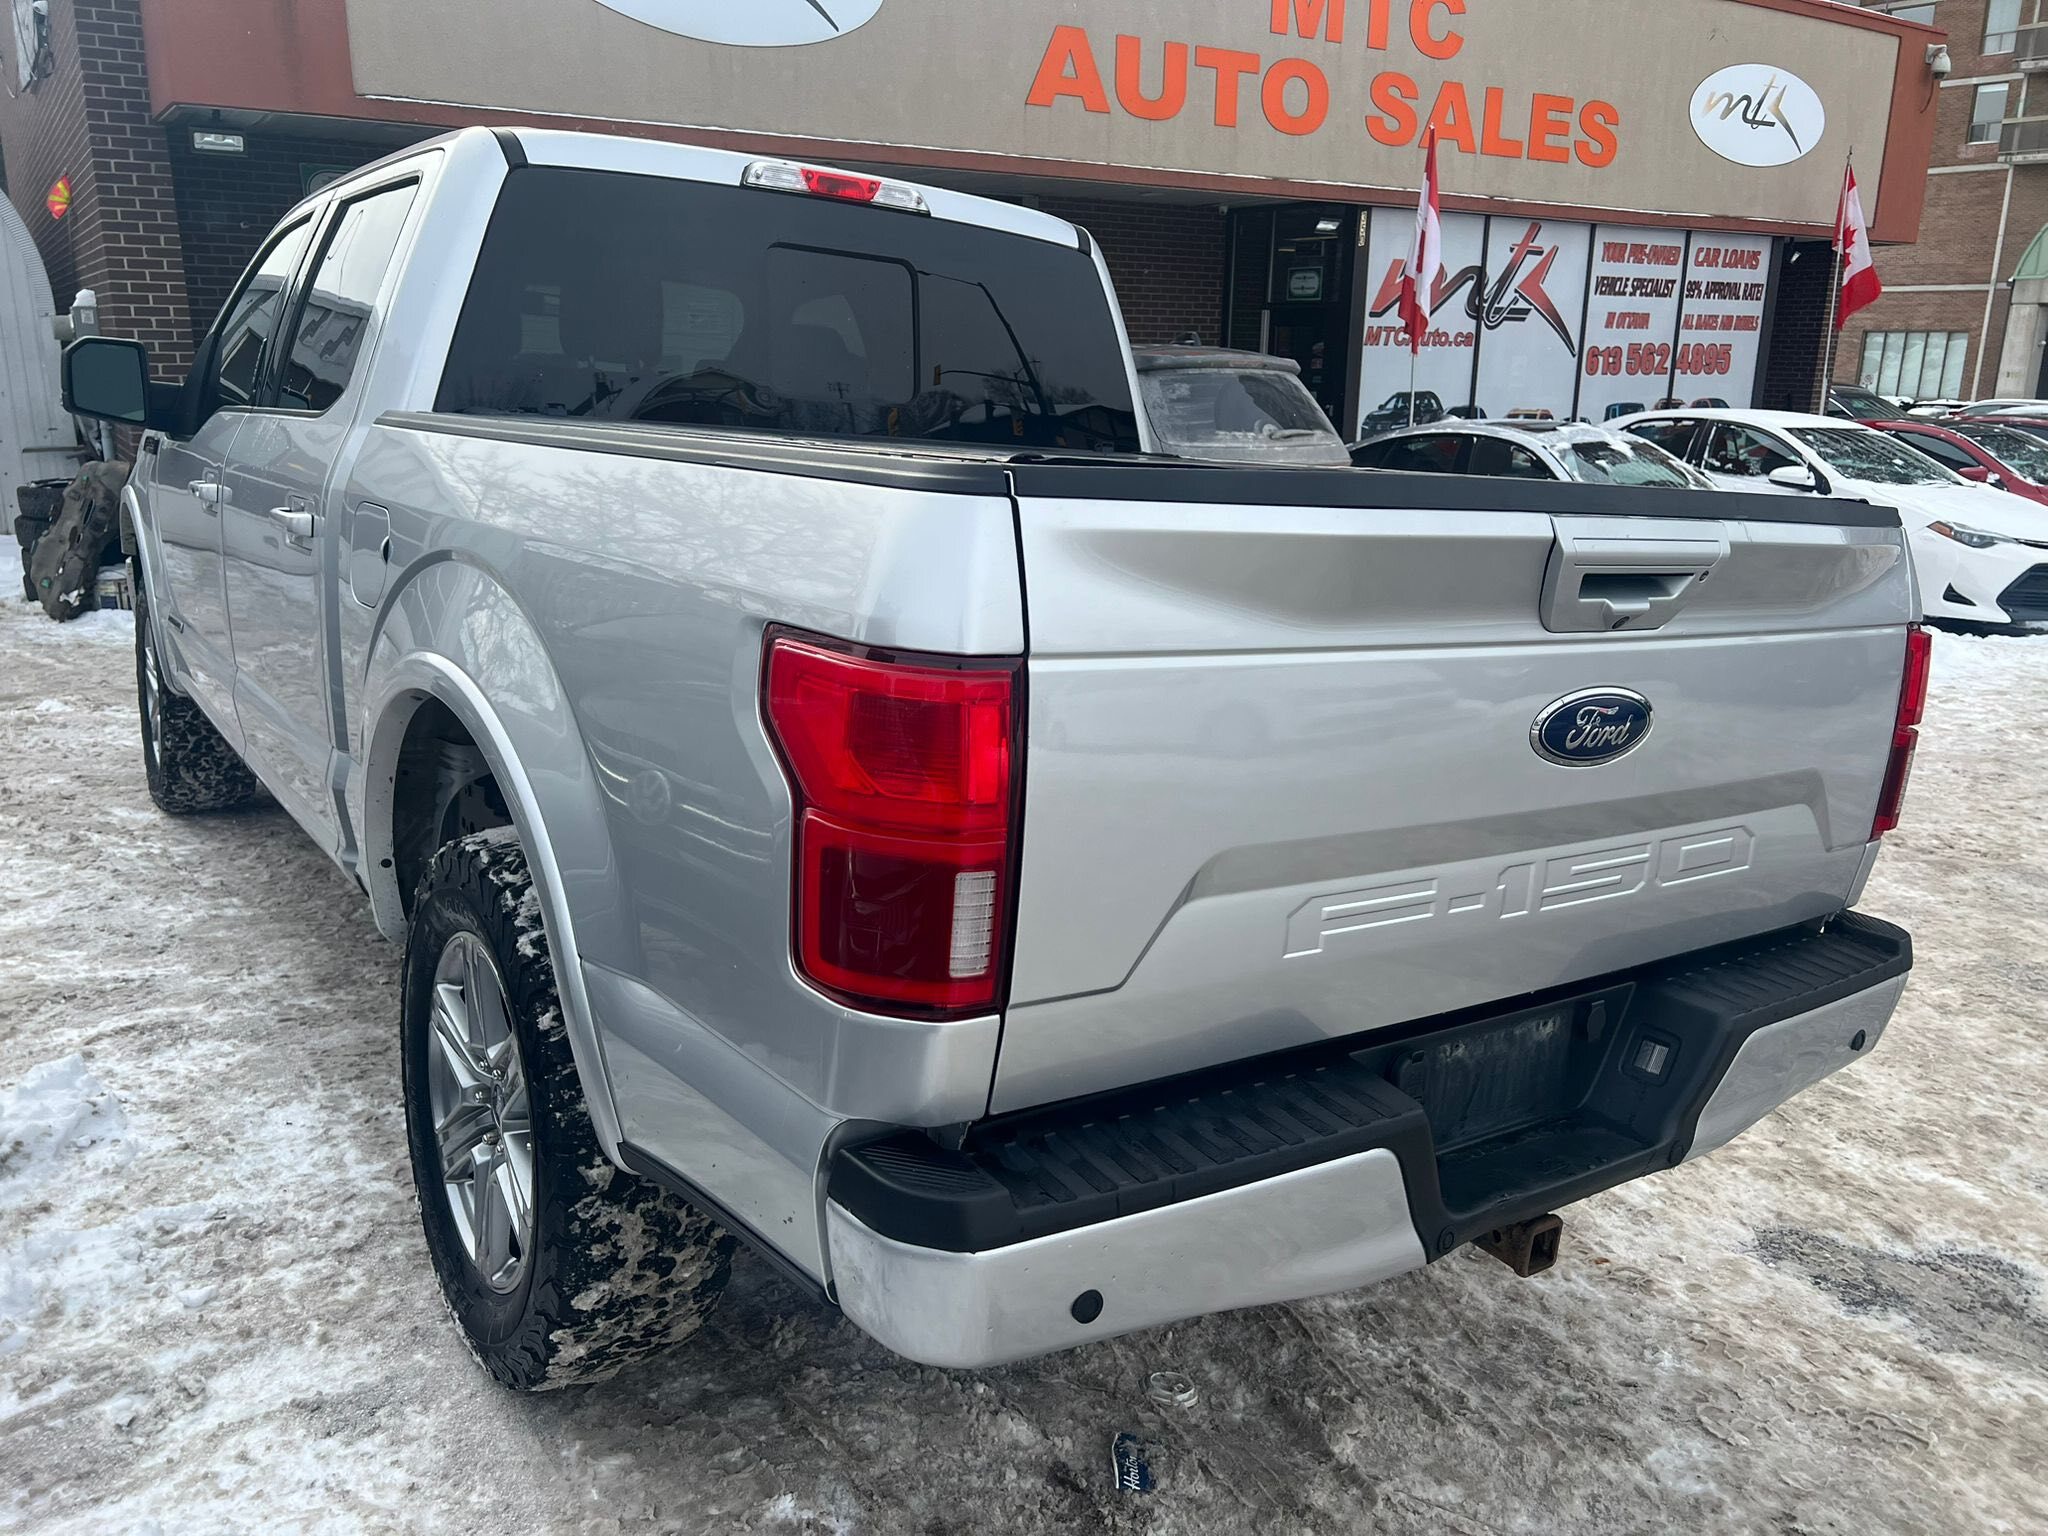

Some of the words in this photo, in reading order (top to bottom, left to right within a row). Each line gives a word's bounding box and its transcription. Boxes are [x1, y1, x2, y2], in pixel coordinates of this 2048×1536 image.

[1025, 24, 1330, 136] AUTO
[1364, 71, 1619, 168] SALES
[1694, 247, 1721, 268] CAR
[1721, 249, 1762, 270] LOANS
[1594, 276, 1630, 297] VEHICLE
[1628, 278, 1678, 298] SPECIALIST
[1685, 280, 1703, 299] 99%
[1702, 281, 1742, 300] APPROVAL
[1363, 326, 1475, 347] MTCuto.ca
[1585, 346, 1623, 376] 613
[1625, 342, 1671, 376] 562
[1676, 343, 1733, 376] 4895
[1565, 706, 1634, 750] Ford
[1282, 825, 1755, 959] F-150
